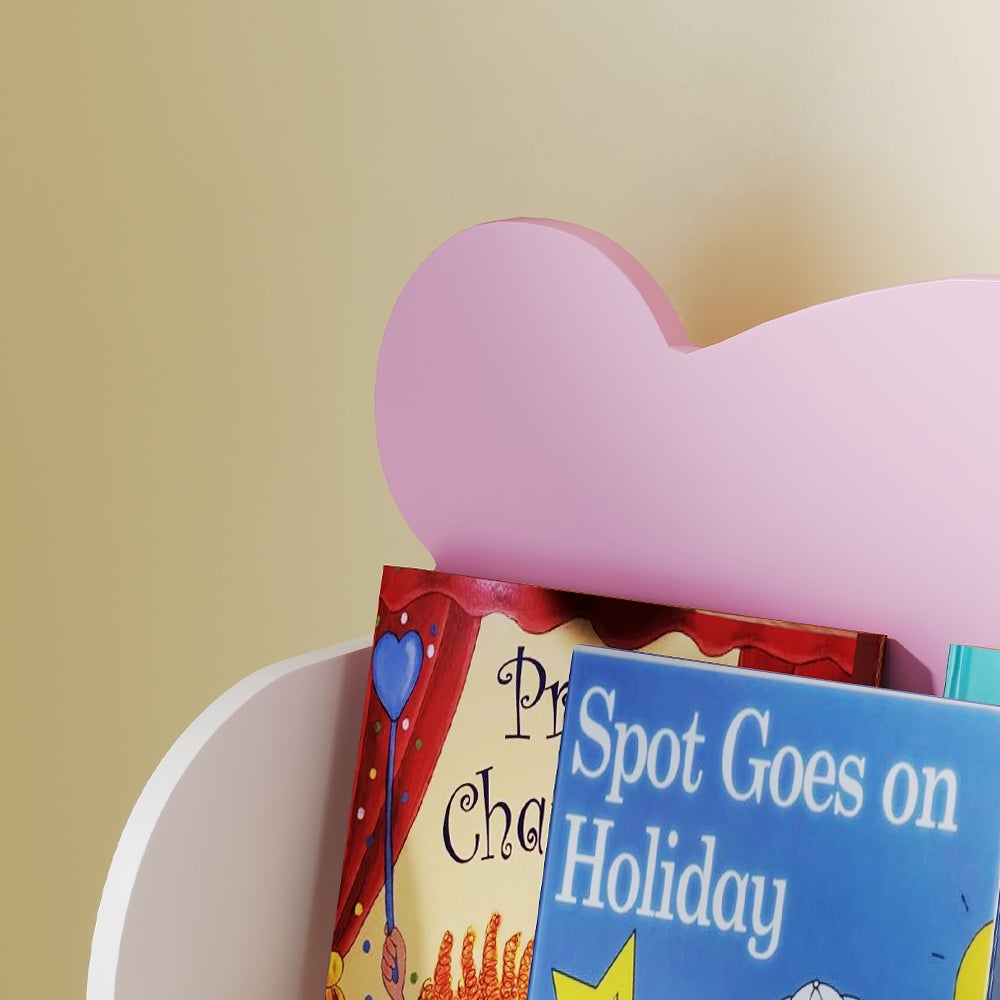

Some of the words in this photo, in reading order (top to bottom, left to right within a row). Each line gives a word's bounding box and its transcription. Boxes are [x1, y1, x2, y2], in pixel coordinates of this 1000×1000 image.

[571, 685, 706, 804] Spot
[721, 707, 866, 818] Goes
[882, 761, 958, 833] on
[554, 813, 787, 960] Holiday
